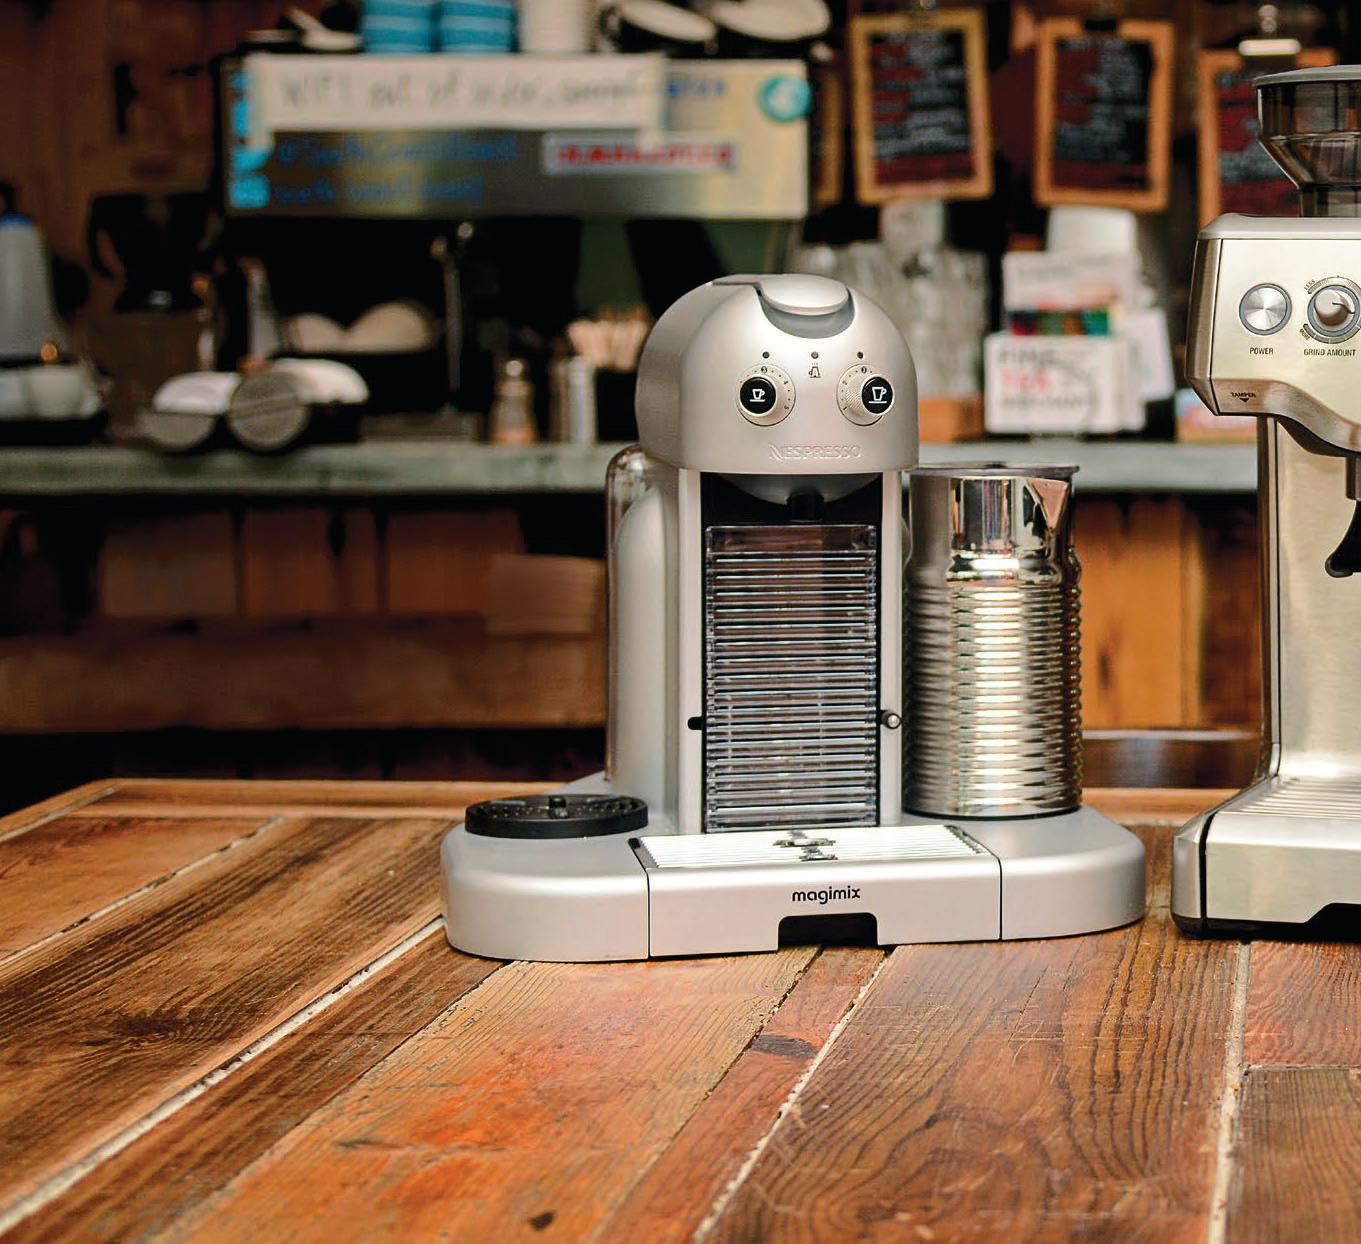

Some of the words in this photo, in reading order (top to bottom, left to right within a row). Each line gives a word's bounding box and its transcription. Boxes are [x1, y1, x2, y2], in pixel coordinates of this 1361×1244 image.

[1249, 347, 1274, 355] POWER
[1303, 348, 1326, 357] GRIND
[1326, 348, 1356, 358] AMOUNT
[768, 443, 863, 461] NESPRESSO
[791, 885, 861, 905] magimix
